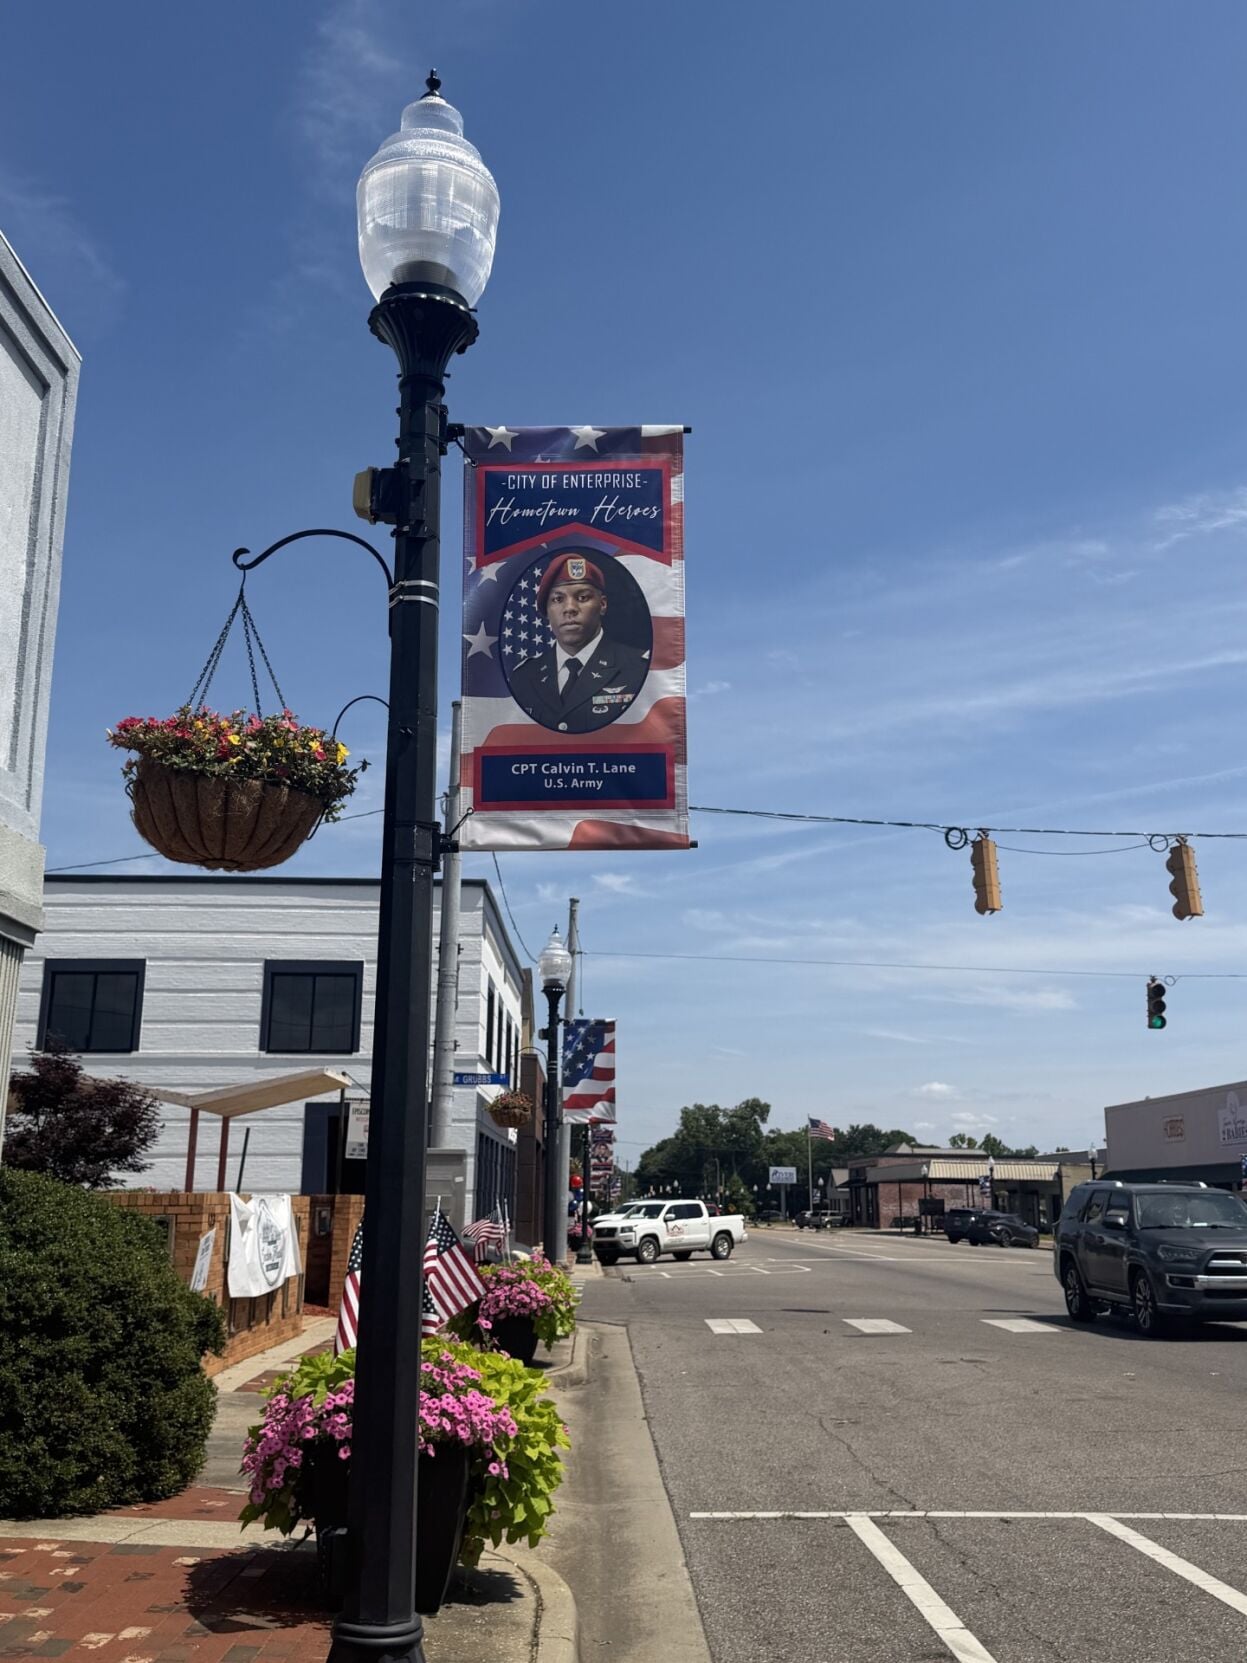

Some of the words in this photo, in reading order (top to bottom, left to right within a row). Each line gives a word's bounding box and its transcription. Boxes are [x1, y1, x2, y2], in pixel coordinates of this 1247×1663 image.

[542, 474, 558, 489] OF
[486, 497, 580, 527] Hometown
[590, 495, 662, 524] Heroes
[511, 763, 537, 775] CPT
[541, 762, 584, 774] Calvin
[587, 762, 599, 774] T.
[603, 762, 636, 774] Lane
[544, 778, 568, 788] U.S.
[571, 778, 603, 790] Army
[462, 1074, 492, 1084] GRUBBS
